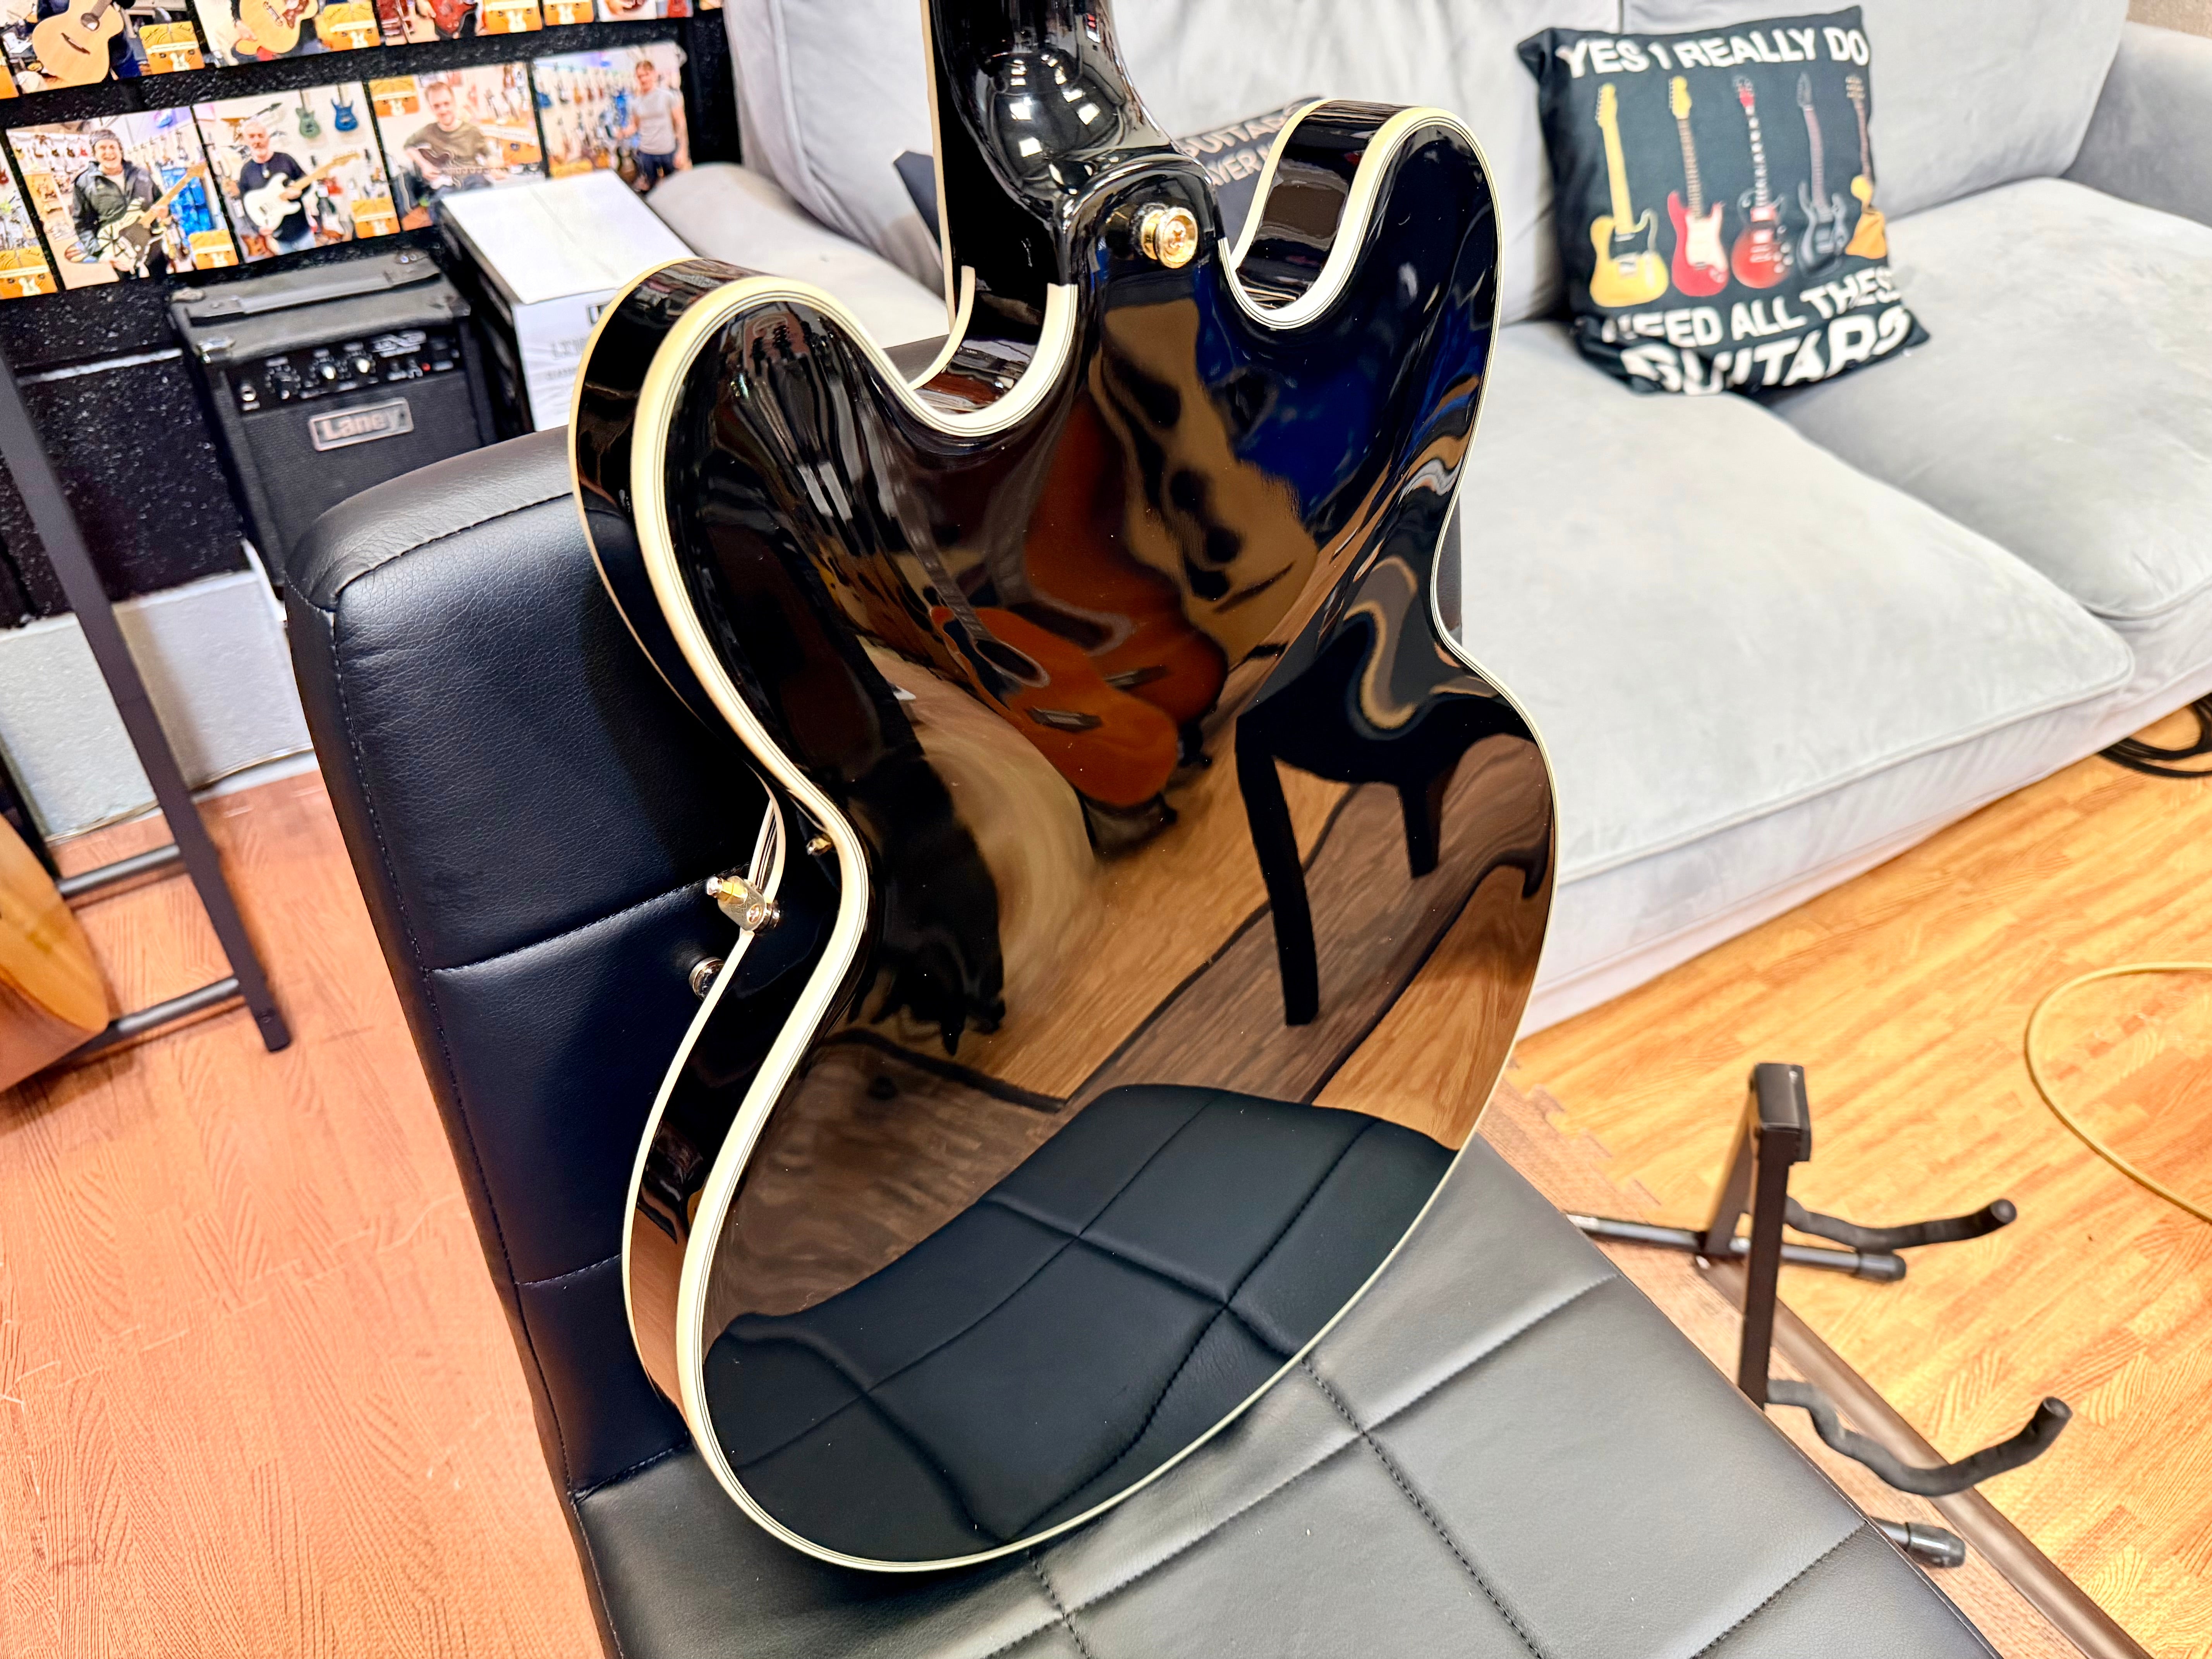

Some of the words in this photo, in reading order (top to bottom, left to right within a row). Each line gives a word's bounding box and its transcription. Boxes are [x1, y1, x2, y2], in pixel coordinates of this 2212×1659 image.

[1555, 38, 1650, 79] YES
[1647, 41, 1673, 70] I
[1672, 27, 1817, 69] REALLY
[1822, 26, 1869, 66] DO
[1731, 296, 1808, 341] ALL
[1799, 266, 1901, 319] THES
[321, 408, 400, 441] Laney
